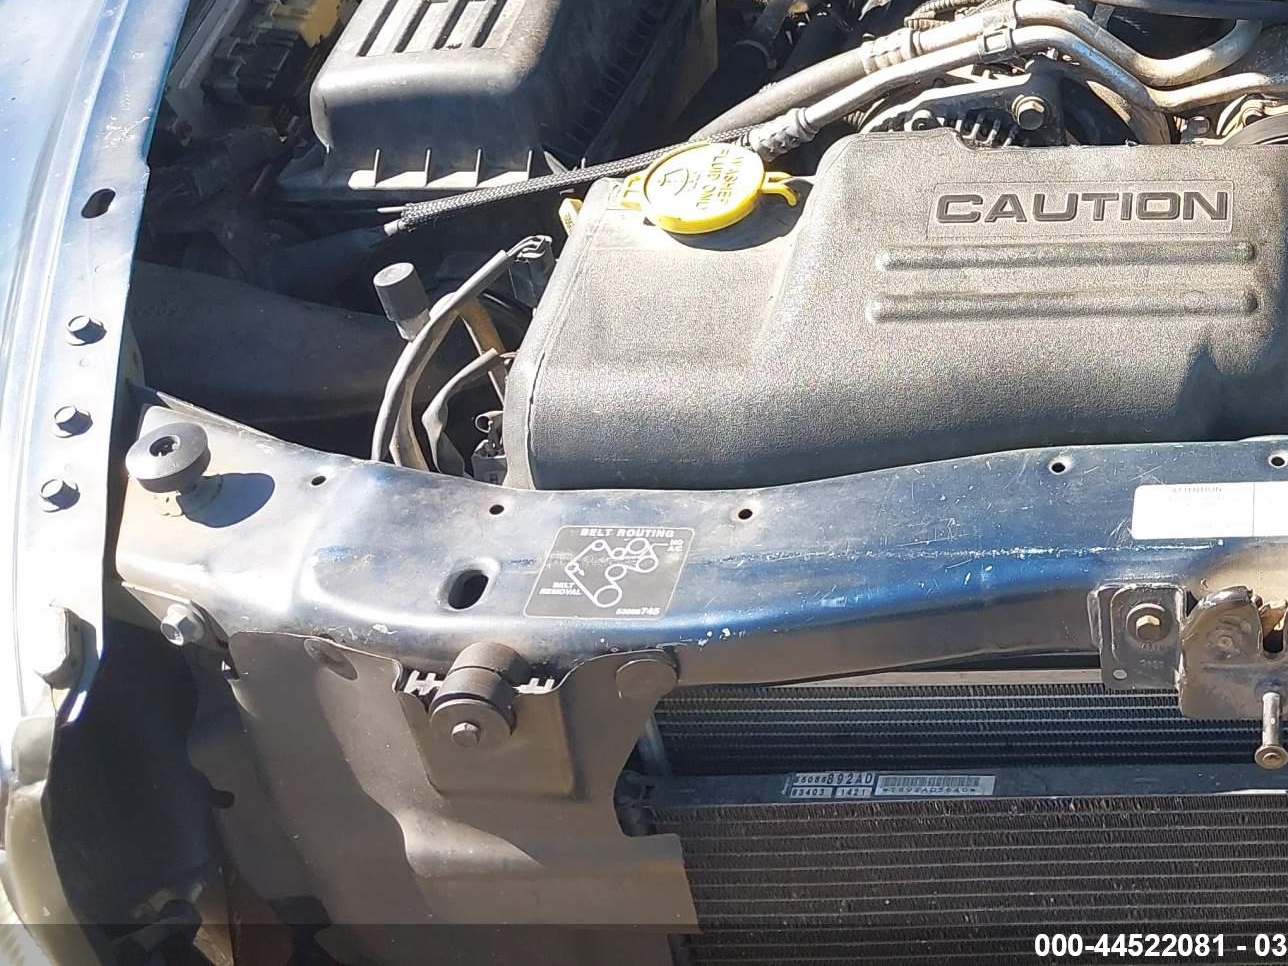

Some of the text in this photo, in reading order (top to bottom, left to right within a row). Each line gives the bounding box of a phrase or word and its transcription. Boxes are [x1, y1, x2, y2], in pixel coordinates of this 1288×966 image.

[935, 190, 1228, 224] CAUTION
[580, 528, 675, 538] BELT ROUTING
[552, 581, 576, 589] BELT
[539, 587, 583, 596] REMOVAL
